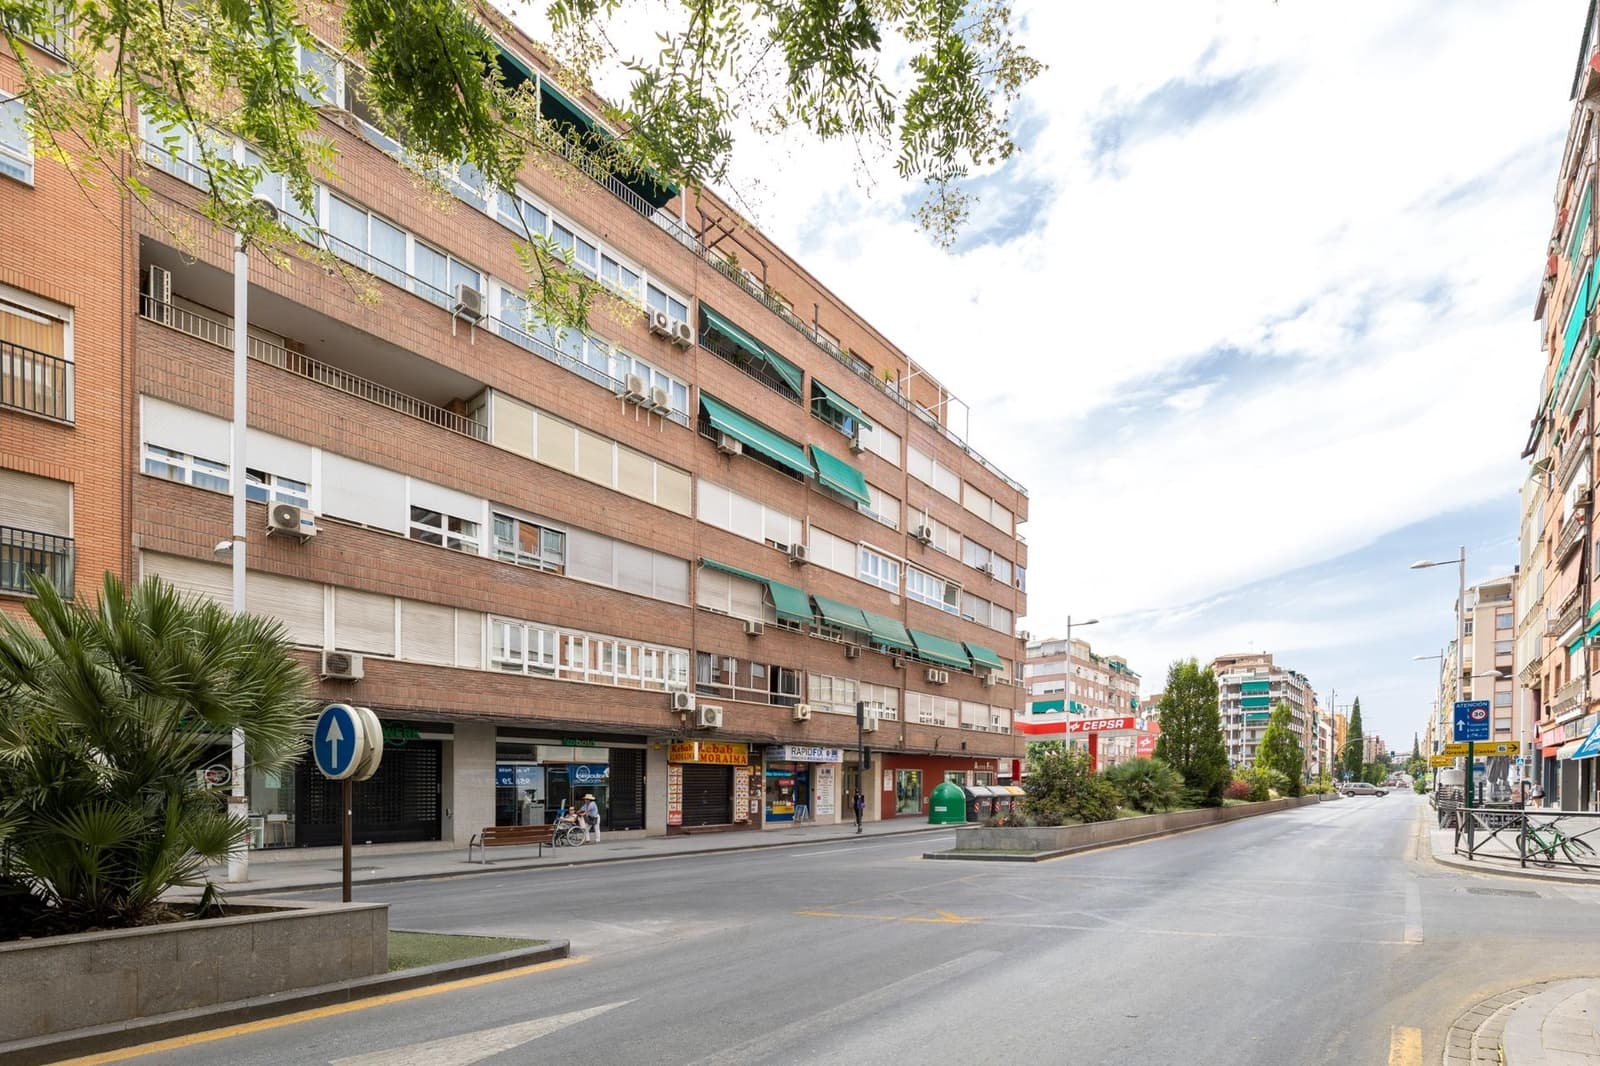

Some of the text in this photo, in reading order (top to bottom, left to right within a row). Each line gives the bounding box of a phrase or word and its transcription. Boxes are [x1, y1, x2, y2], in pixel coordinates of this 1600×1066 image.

[1082, 720, 1125, 731] CEPSA
[699, 743, 733, 754] Kebab
[700, 753, 747, 764] MORAIMA
